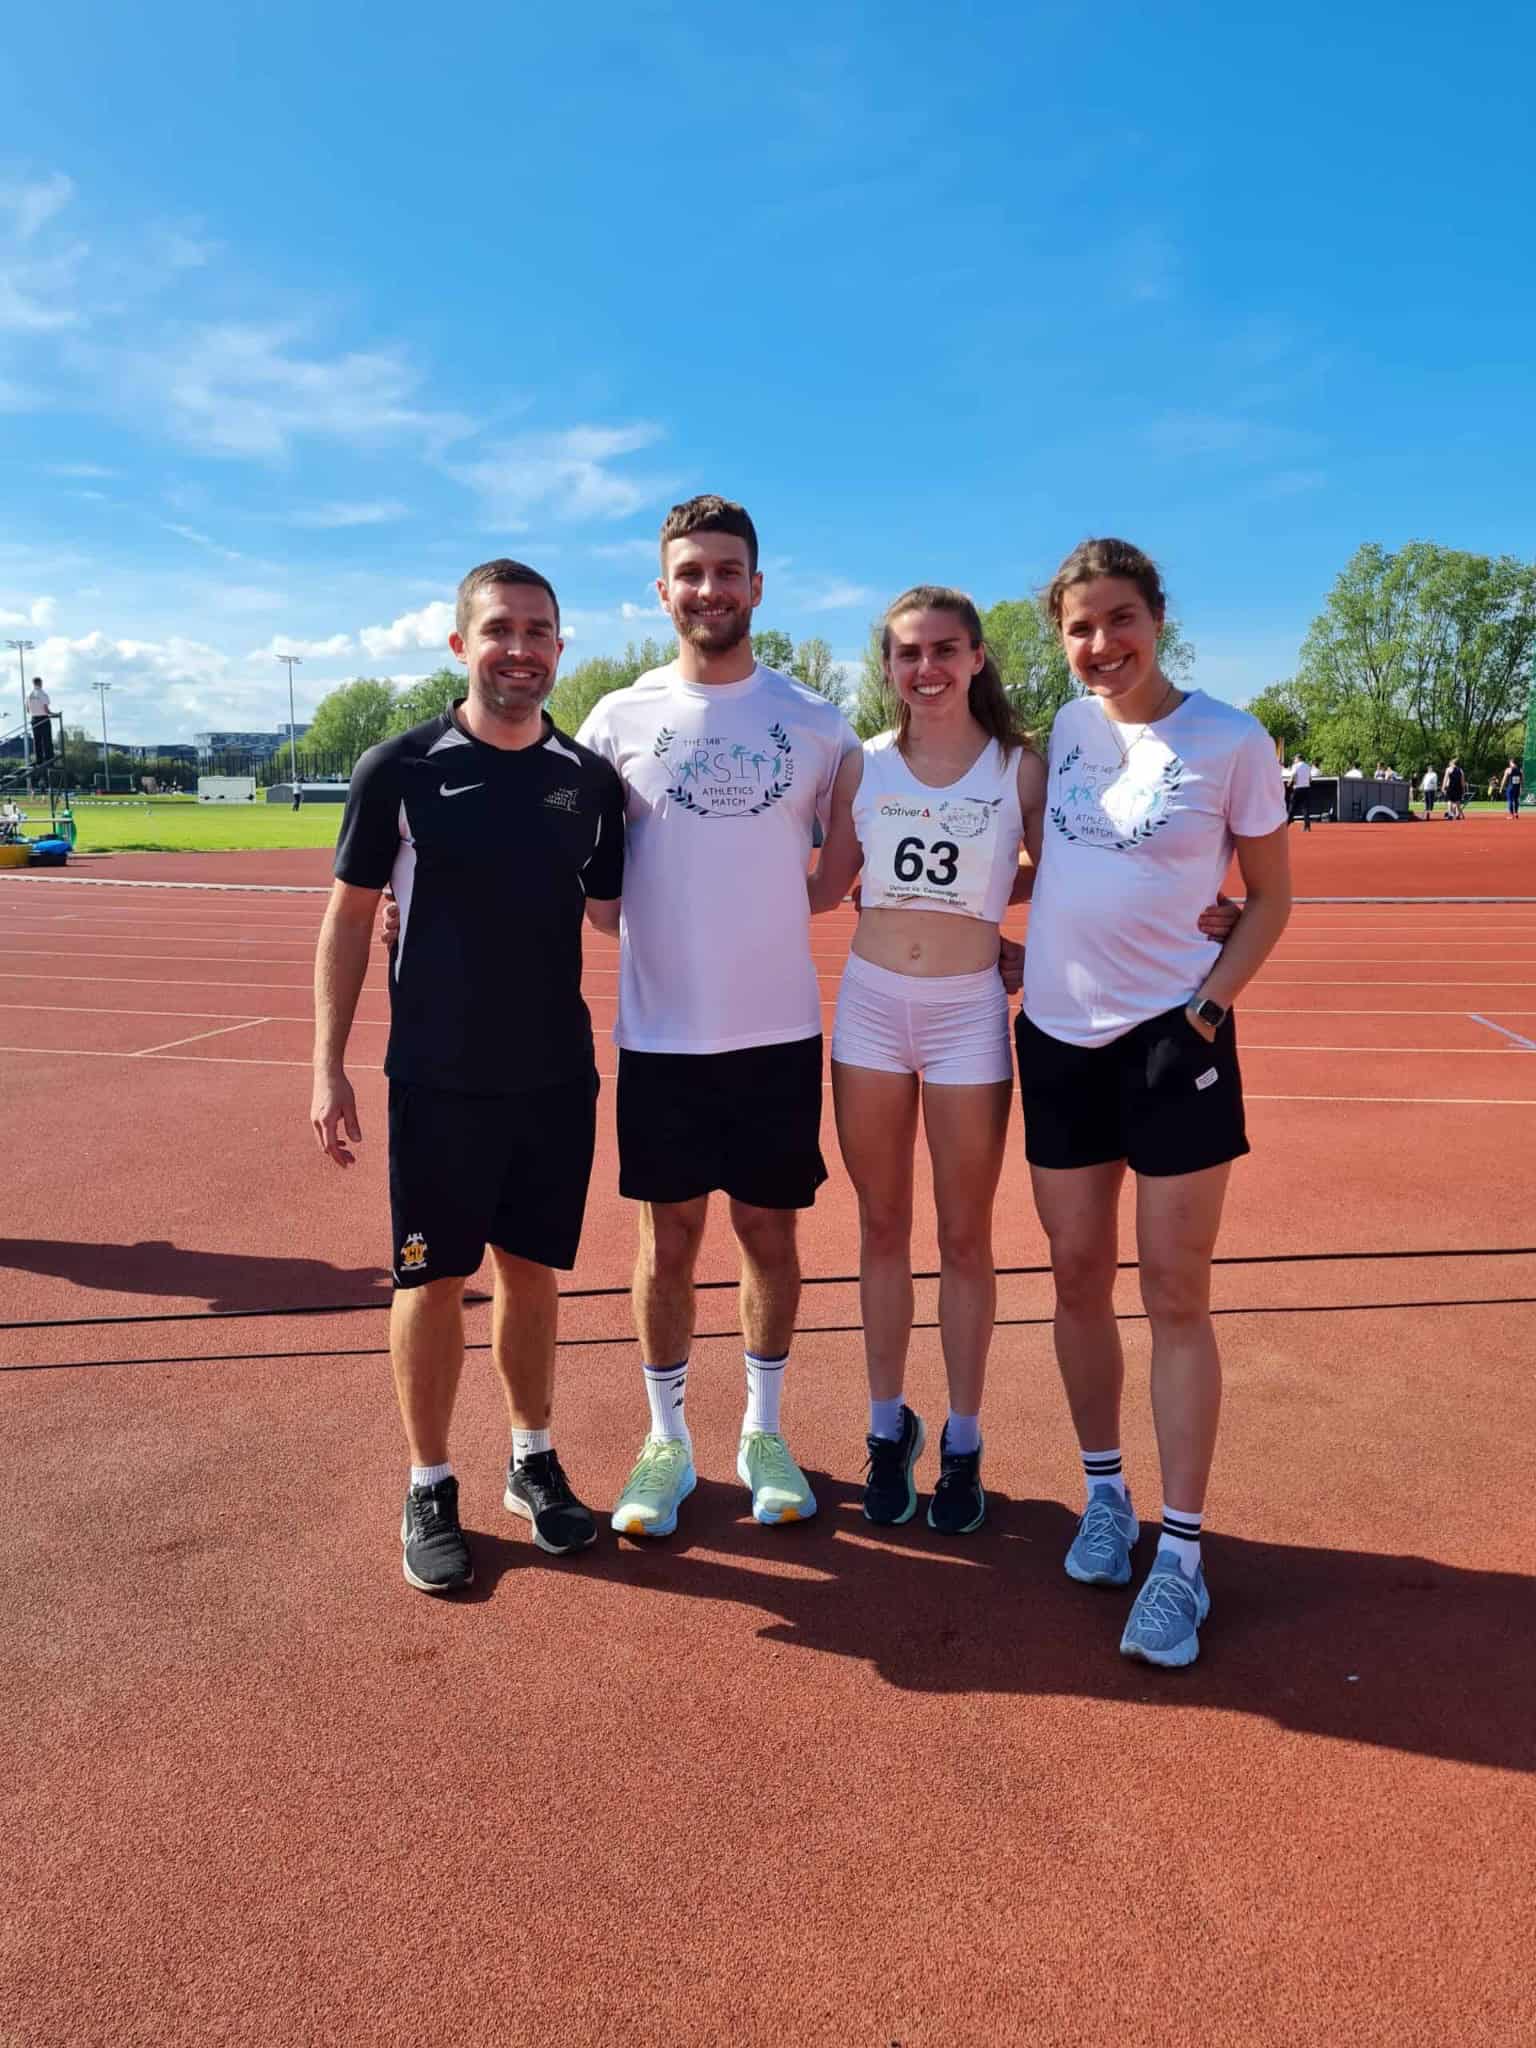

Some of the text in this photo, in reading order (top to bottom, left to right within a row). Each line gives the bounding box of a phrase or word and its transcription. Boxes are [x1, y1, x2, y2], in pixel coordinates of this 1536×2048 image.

[702, 786, 754, 797] ATHLETICS
[711, 798, 746, 808] MATCH
[880, 805, 922, 817] Optiver
[894, 836, 960, 887] 63
